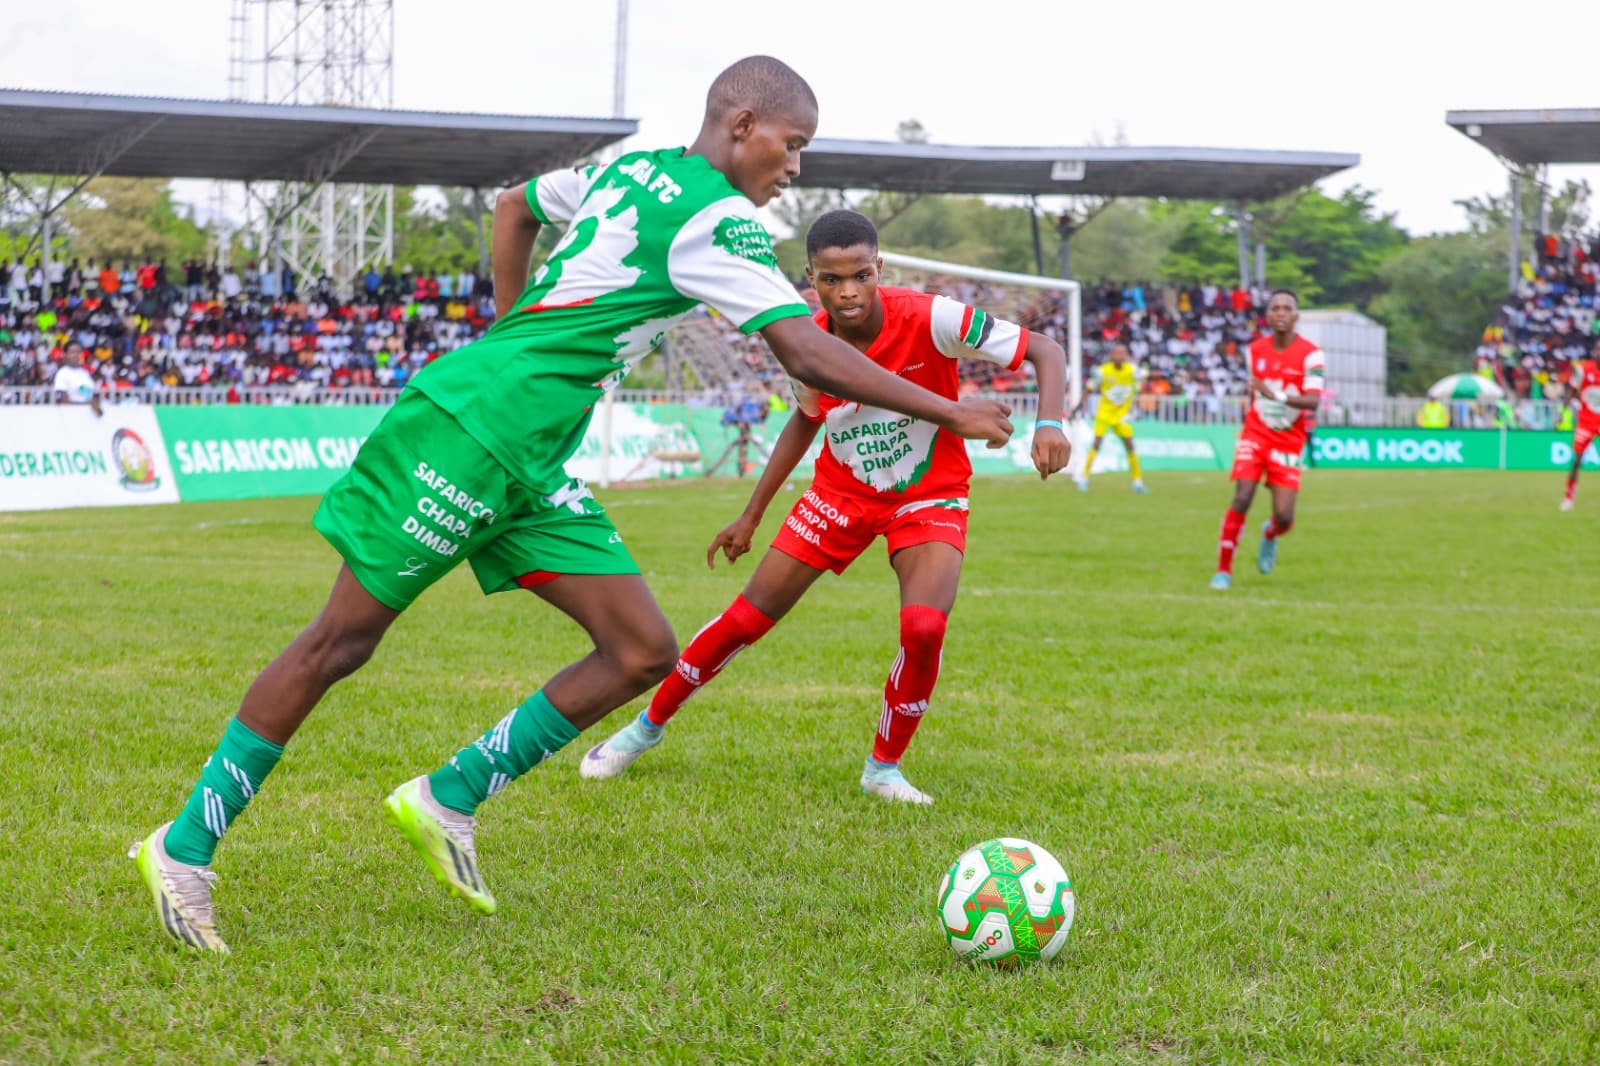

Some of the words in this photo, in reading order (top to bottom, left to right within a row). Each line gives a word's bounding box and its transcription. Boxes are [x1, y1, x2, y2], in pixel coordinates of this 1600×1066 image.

[647, 171, 683, 204] FC
[174, 436, 319, 475] SAFARICOM
[856, 430, 909, 456] CHAPA
[862, 442, 913, 474] DIMBA
[1376, 438, 1464, 463] HOOK
[417, 496, 472, 539] CHAPA
[402, 515, 460, 557] DIMBA
